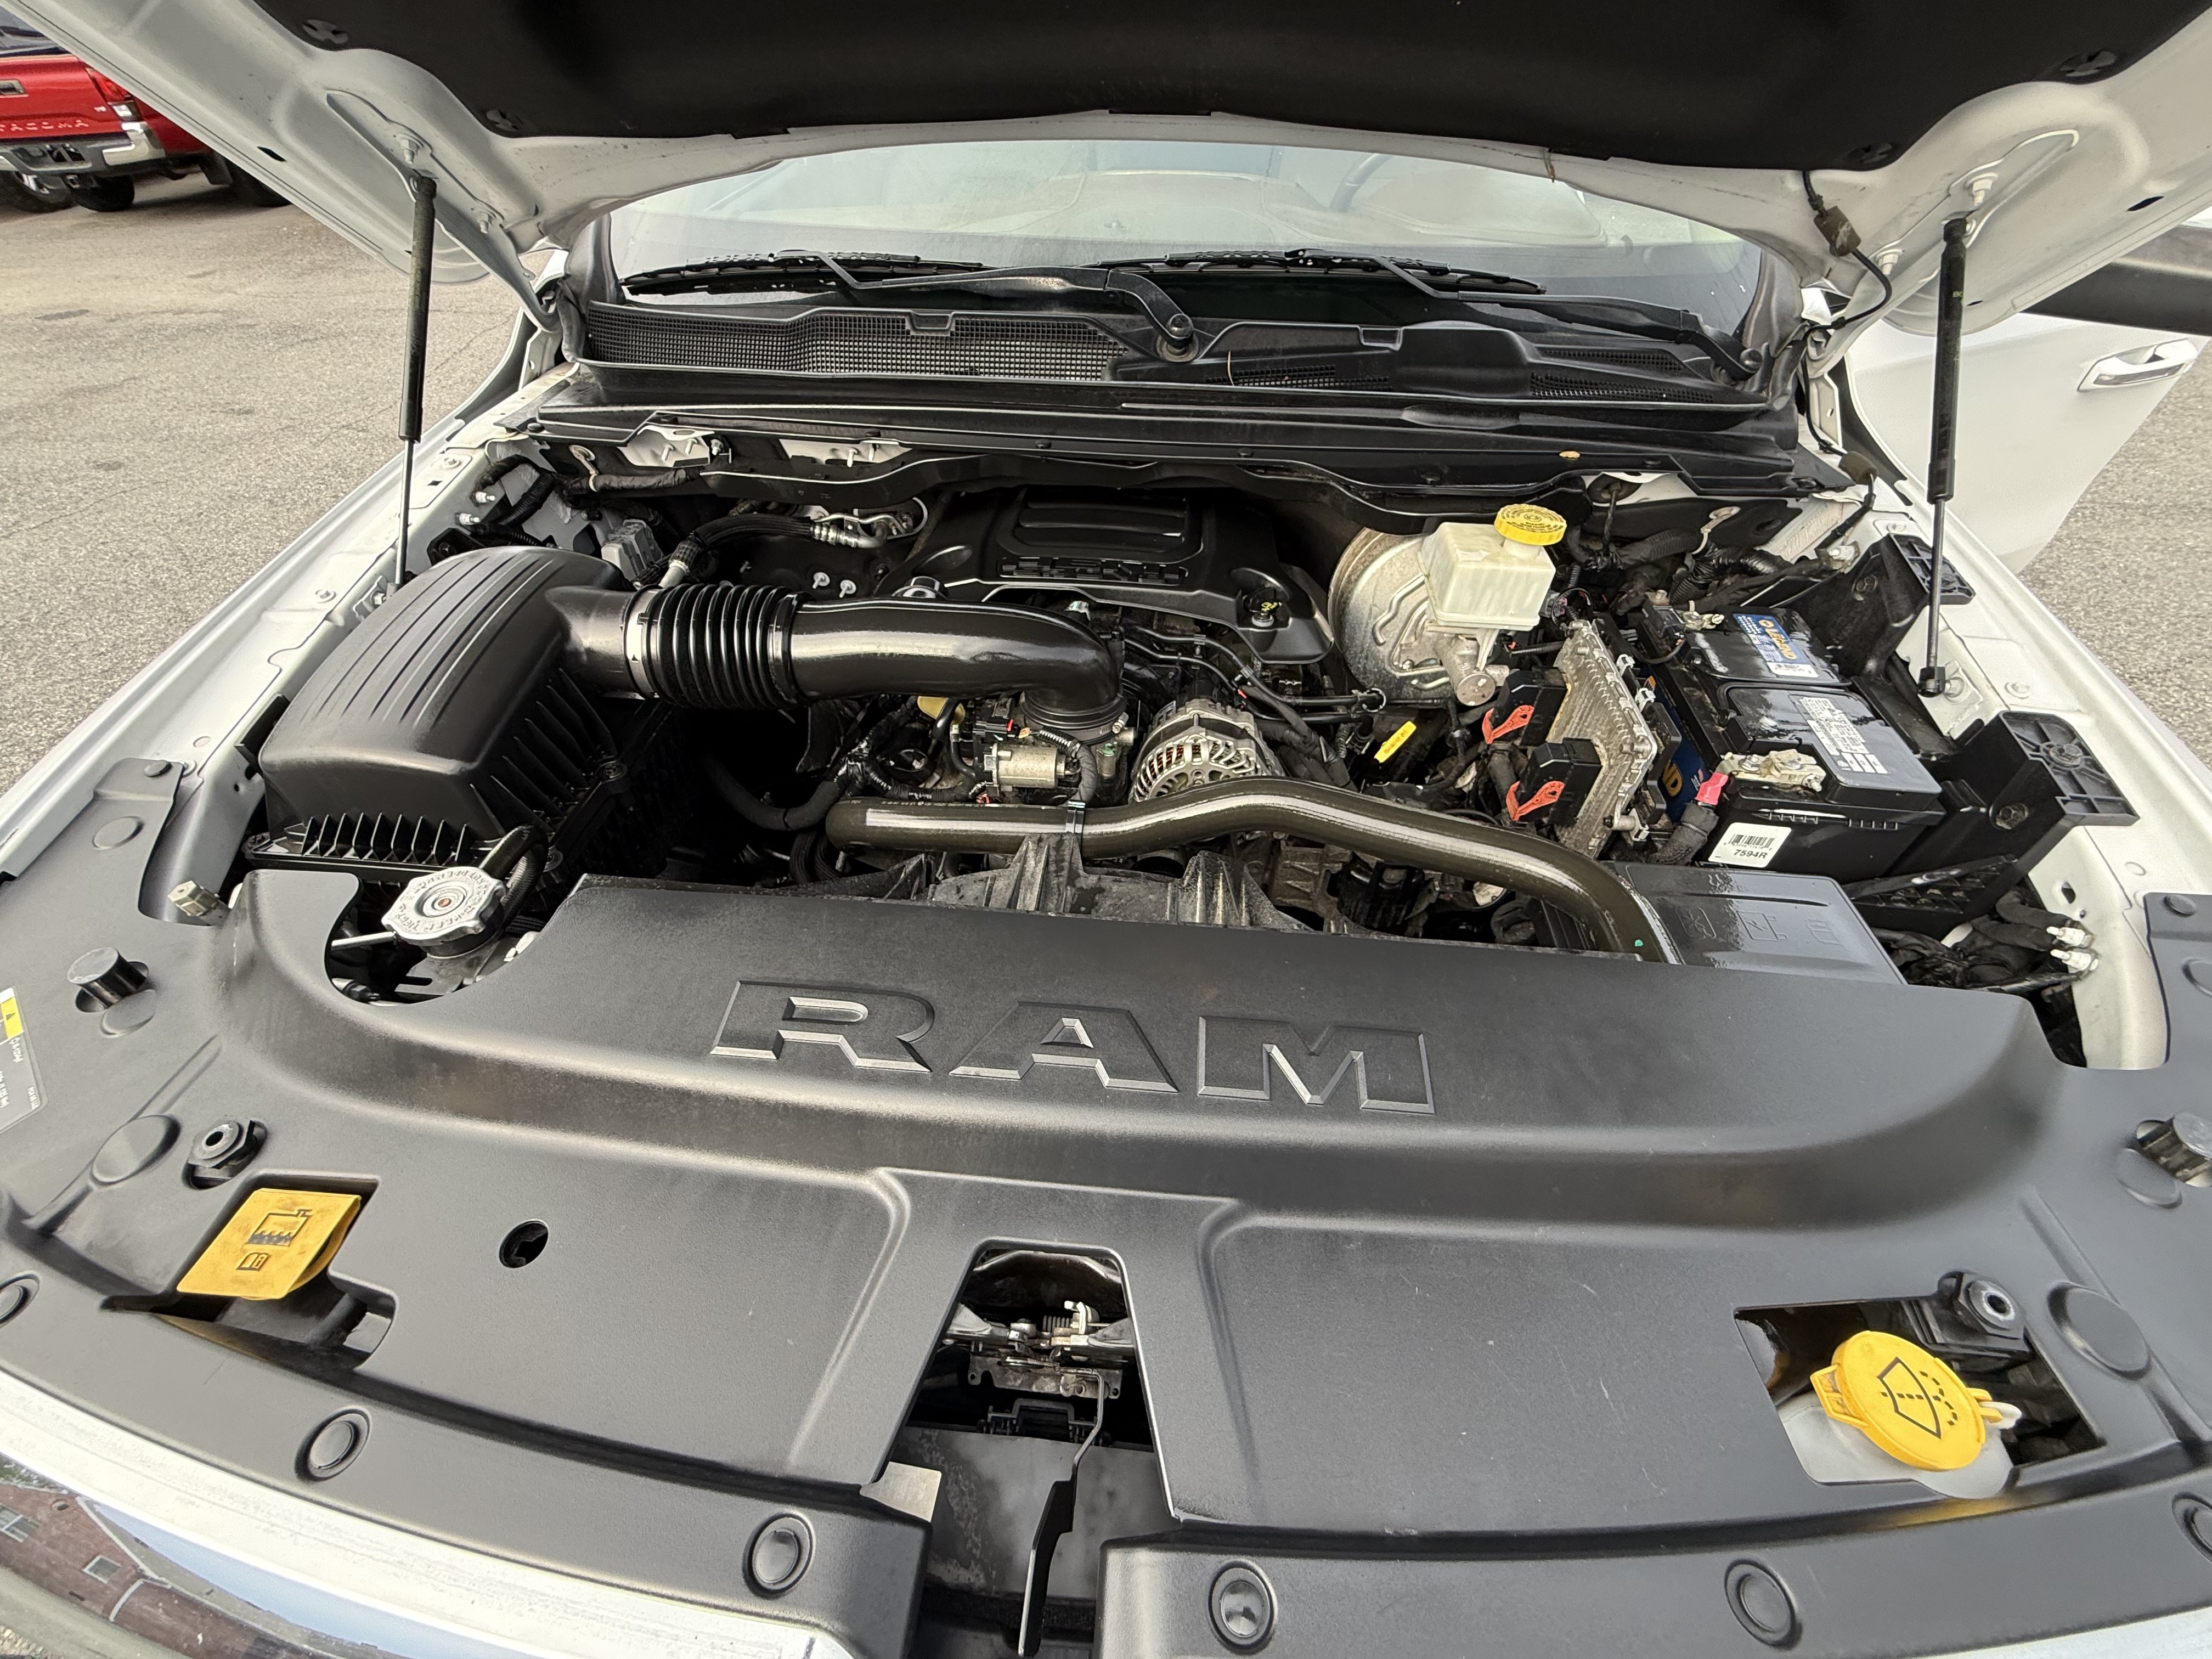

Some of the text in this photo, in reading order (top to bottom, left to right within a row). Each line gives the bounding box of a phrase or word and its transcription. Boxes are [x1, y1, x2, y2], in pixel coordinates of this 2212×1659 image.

[1764, 628, 1797, 660] LEGEND
[1734, 849, 1768, 859] 7594R
[709, 979, 1436, 1115] RAM
